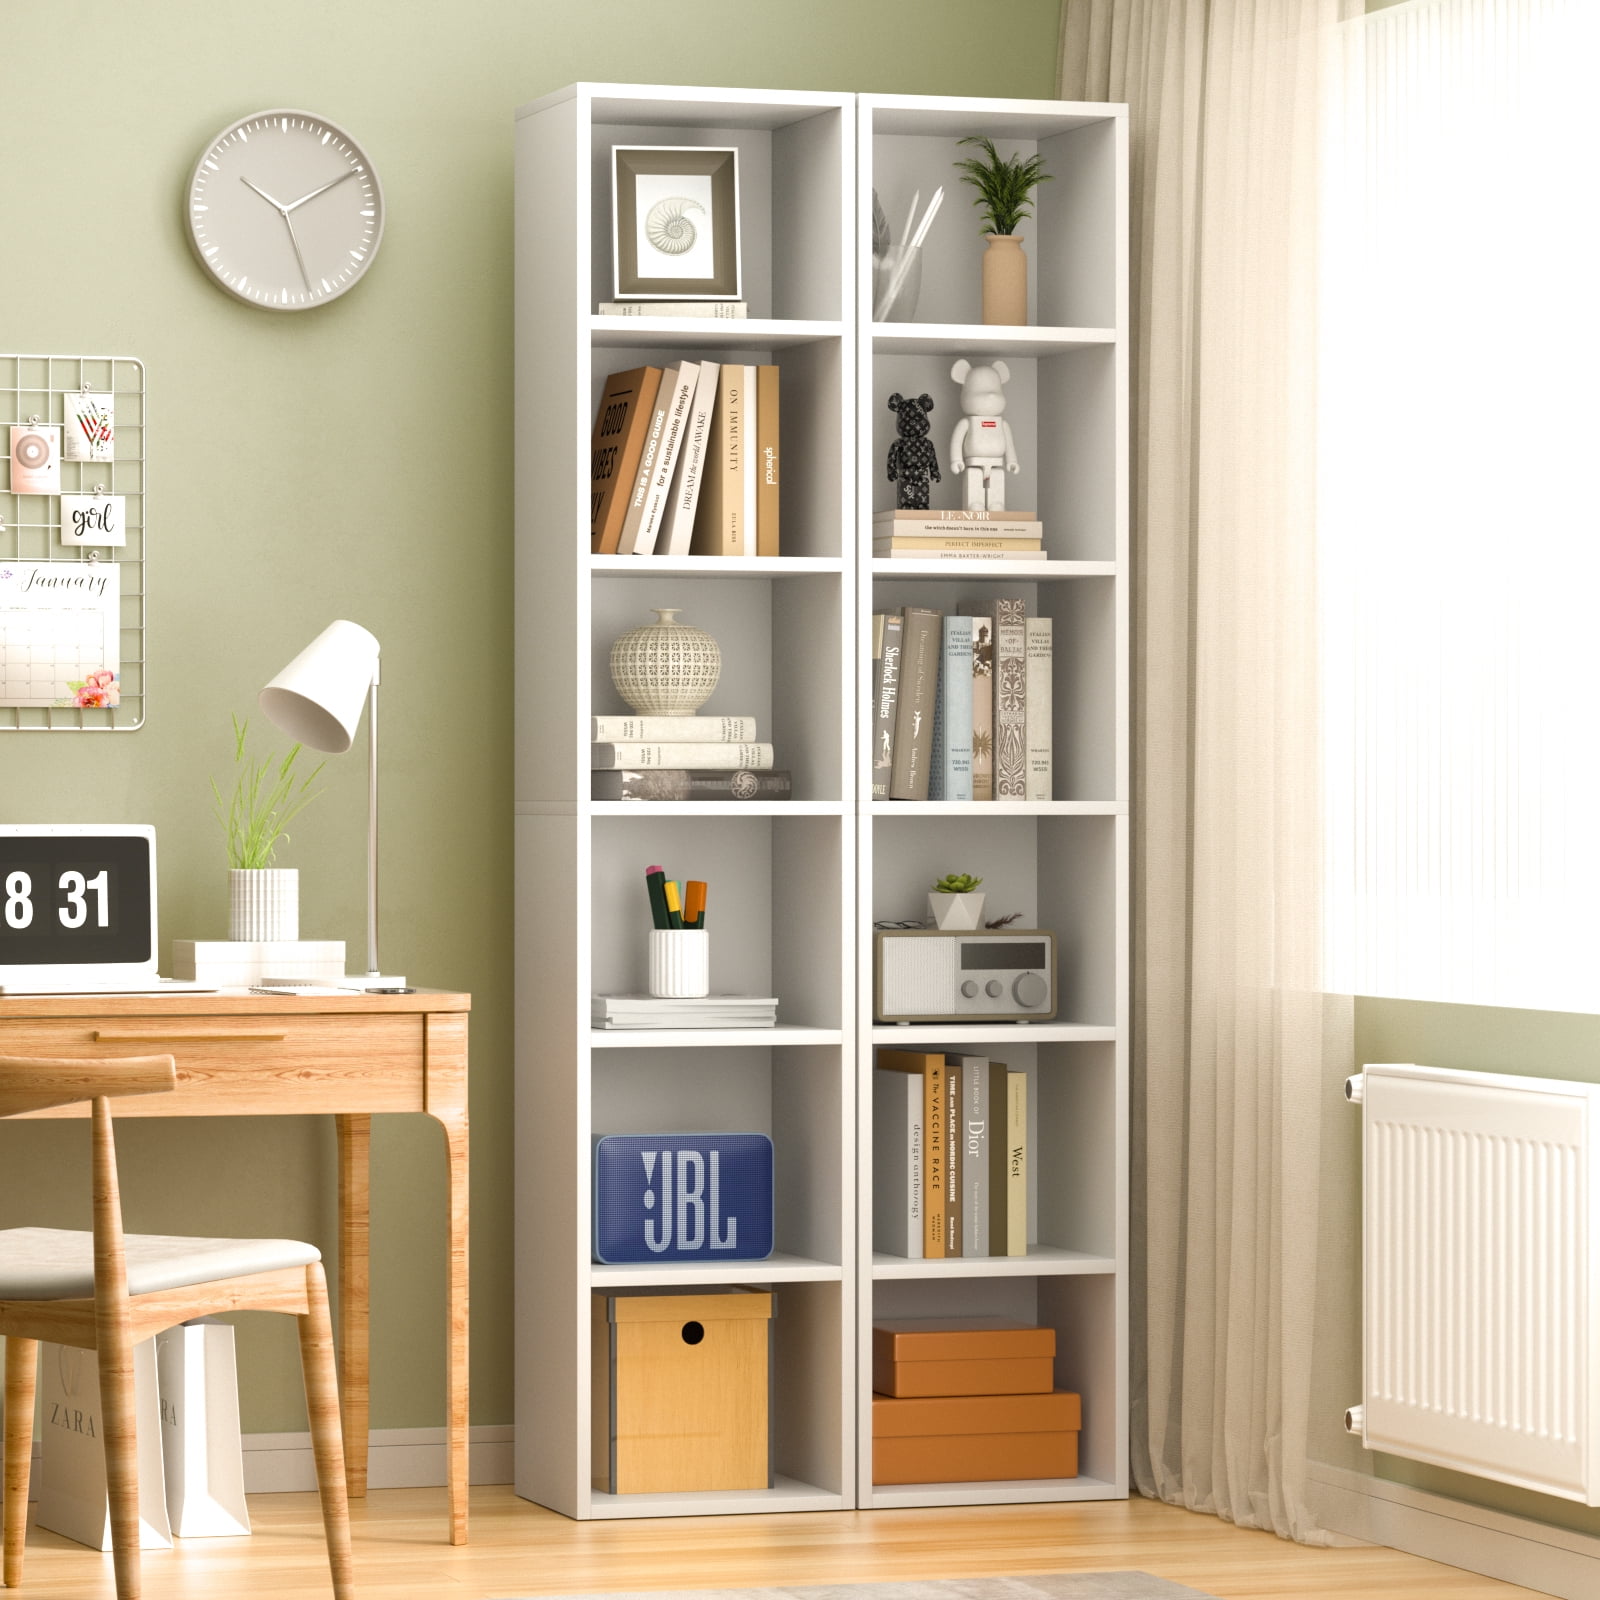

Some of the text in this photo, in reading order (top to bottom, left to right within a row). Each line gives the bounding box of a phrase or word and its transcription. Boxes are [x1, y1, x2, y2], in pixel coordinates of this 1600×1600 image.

[601, 402, 628, 437] GOOD
[656, 475, 666, 487] for
[664, 418, 681, 466] sustainable
[675, 385, 689, 418] lifestyle
[694, 411, 706, 445] AWAKE
[729, 388, 738, 472] ON IMMUNITY
[633, 409, 665, 508] THIS IS A GOOD GUIDE
[692, 444, 700, 464] world
[763, 447, 776, 485] spherical
[682, 475, 696, 510] DREAM
[72, 503, 115, 536] girl
[941, 511, 990, 521] LE NOIR
[21, 568, 107, 597] January
[883, 646, 900, 684] Sherlock
[880, 687, 896, 719] Holmes
[5, 870, 109, 929] 8 31
[968, 1120, 985, 1158] Dior
[912, 1124, 921, 1219] design anthology
[1012, 1146, 1023, 1177] West
[642, 1150, 736, 1252] JBL
[51, 1402, 96, 1438] ZARA
[161, 1398, 177, 1426] RA
